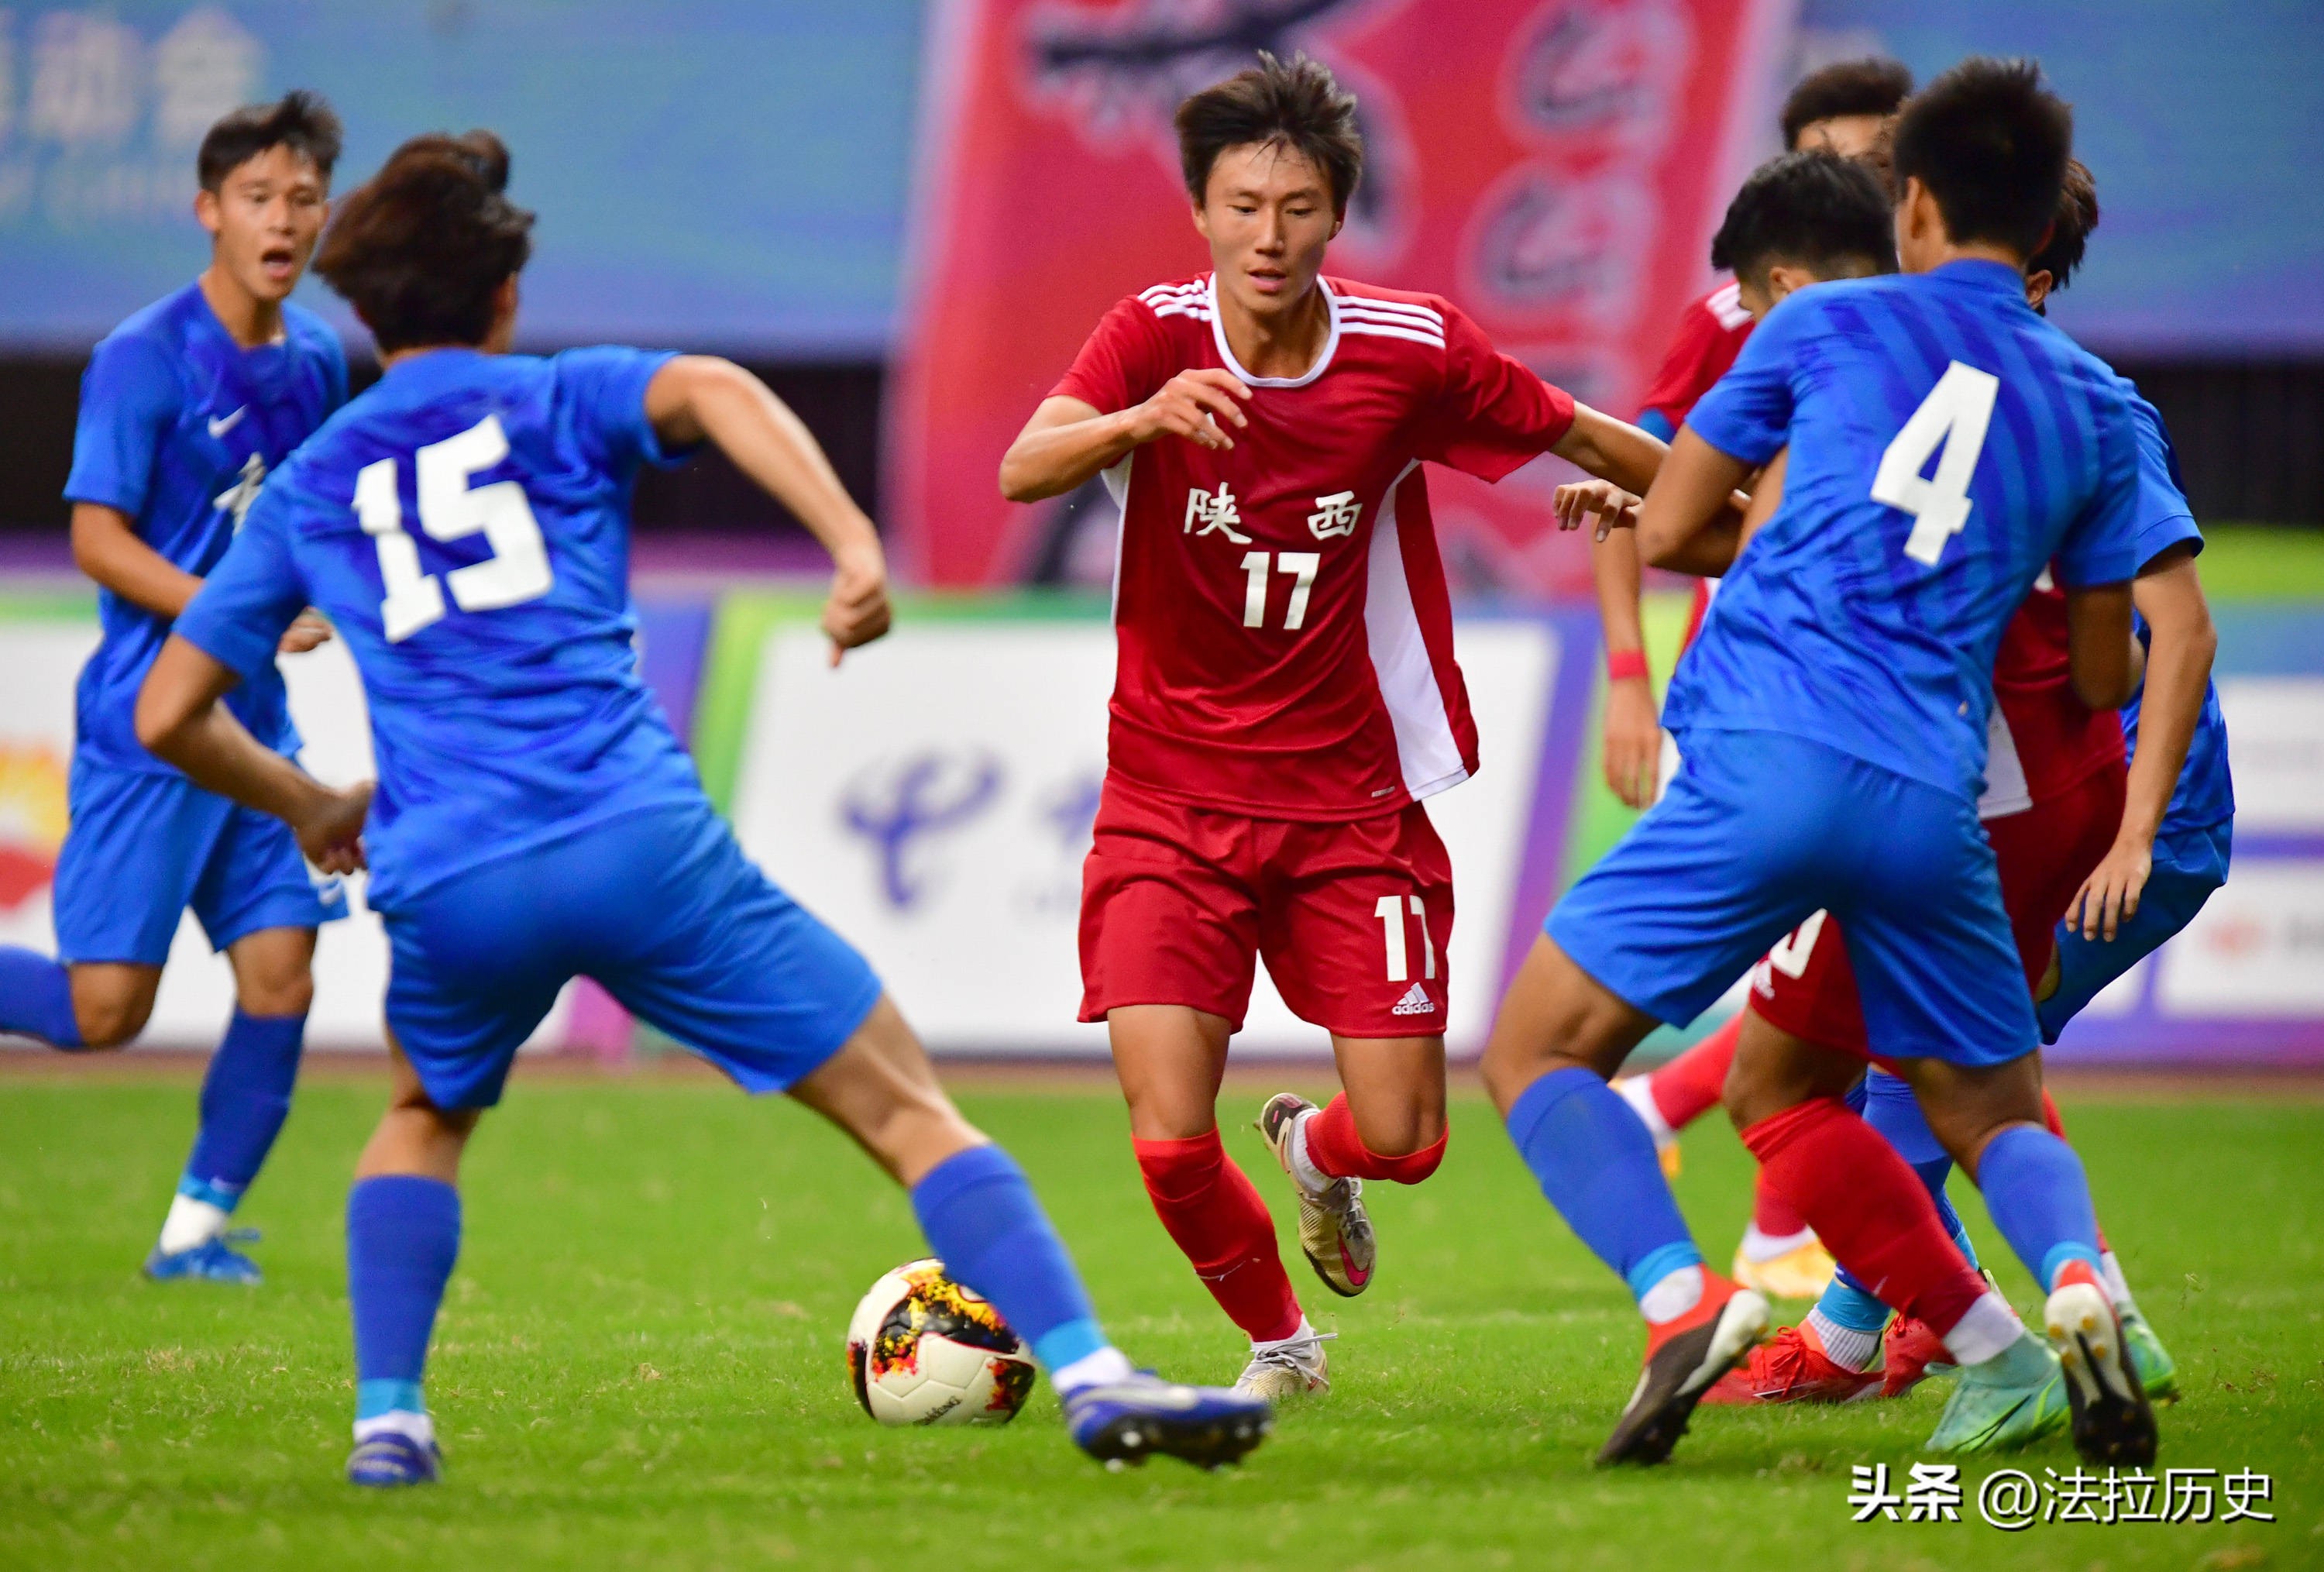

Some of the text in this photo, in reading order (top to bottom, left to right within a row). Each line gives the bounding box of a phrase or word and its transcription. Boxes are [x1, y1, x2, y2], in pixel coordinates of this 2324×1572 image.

[1870, 359, 2000, 567] 4
[351, 413, 554, 644] 15
[1184, 481, 1363, 544] 陕西
[1239, 551, 1321, 630] 17
[1391, 1002, 1435, 1016] adidas
